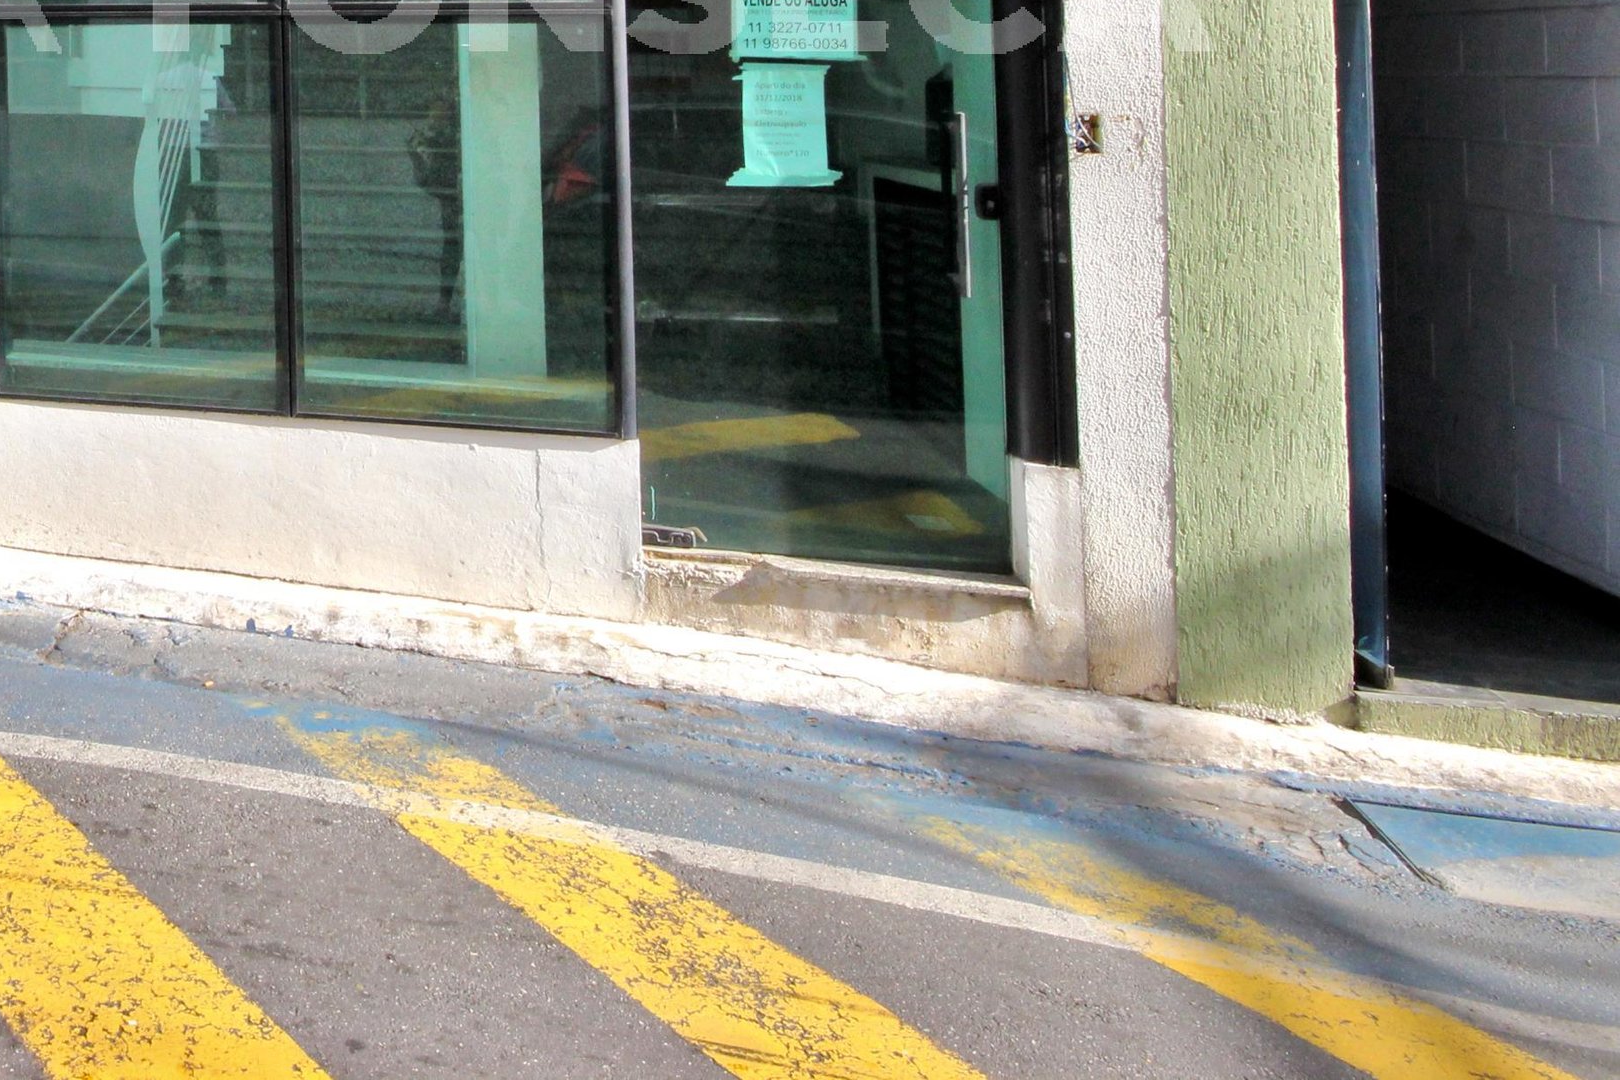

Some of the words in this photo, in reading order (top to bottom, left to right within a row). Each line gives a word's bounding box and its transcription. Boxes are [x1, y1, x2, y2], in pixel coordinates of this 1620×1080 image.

[748, 22, 761, 33] 11
[768, 21, 842, 34] 3227-0711
[744, 38, 757, 49] 11
[762, 37, 848, 50] 98766-0034
